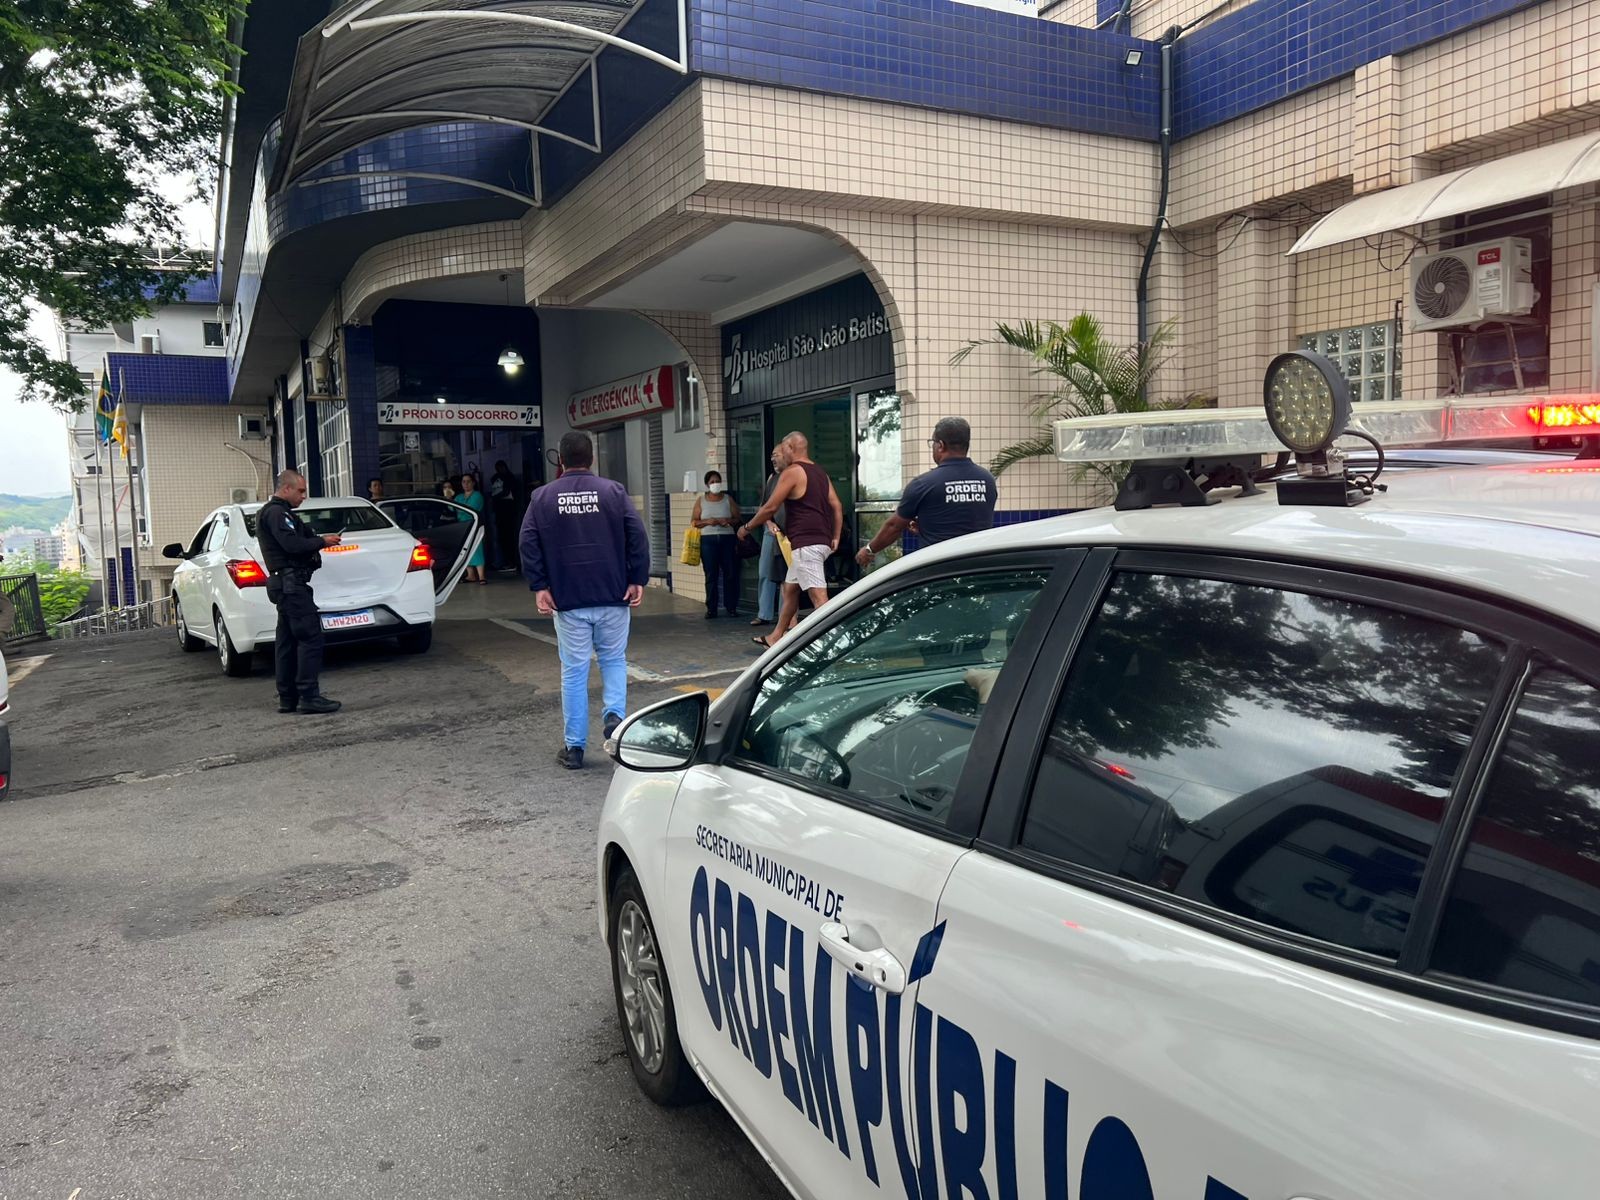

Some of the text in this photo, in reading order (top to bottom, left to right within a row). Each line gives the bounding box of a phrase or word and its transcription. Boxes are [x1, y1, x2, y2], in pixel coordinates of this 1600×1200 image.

[1480, 252, 1498, 261] TCL
[750, 312, 889, 370] Hospital São João Batist
[402, 408, 518, 420] PRONTO SOCORRO
[945, 484, 986, 494] ORDEM
[558, 495, 599, 505] ORDEM
[945, 492, 987, 503] PÚBLICA
[558, 503, 600, 515] PÚBLICA
[695, 824, 845, 923] SECRETARIA MUNICIPAL DE
[690, 865, 851, 1161] ORDEM
